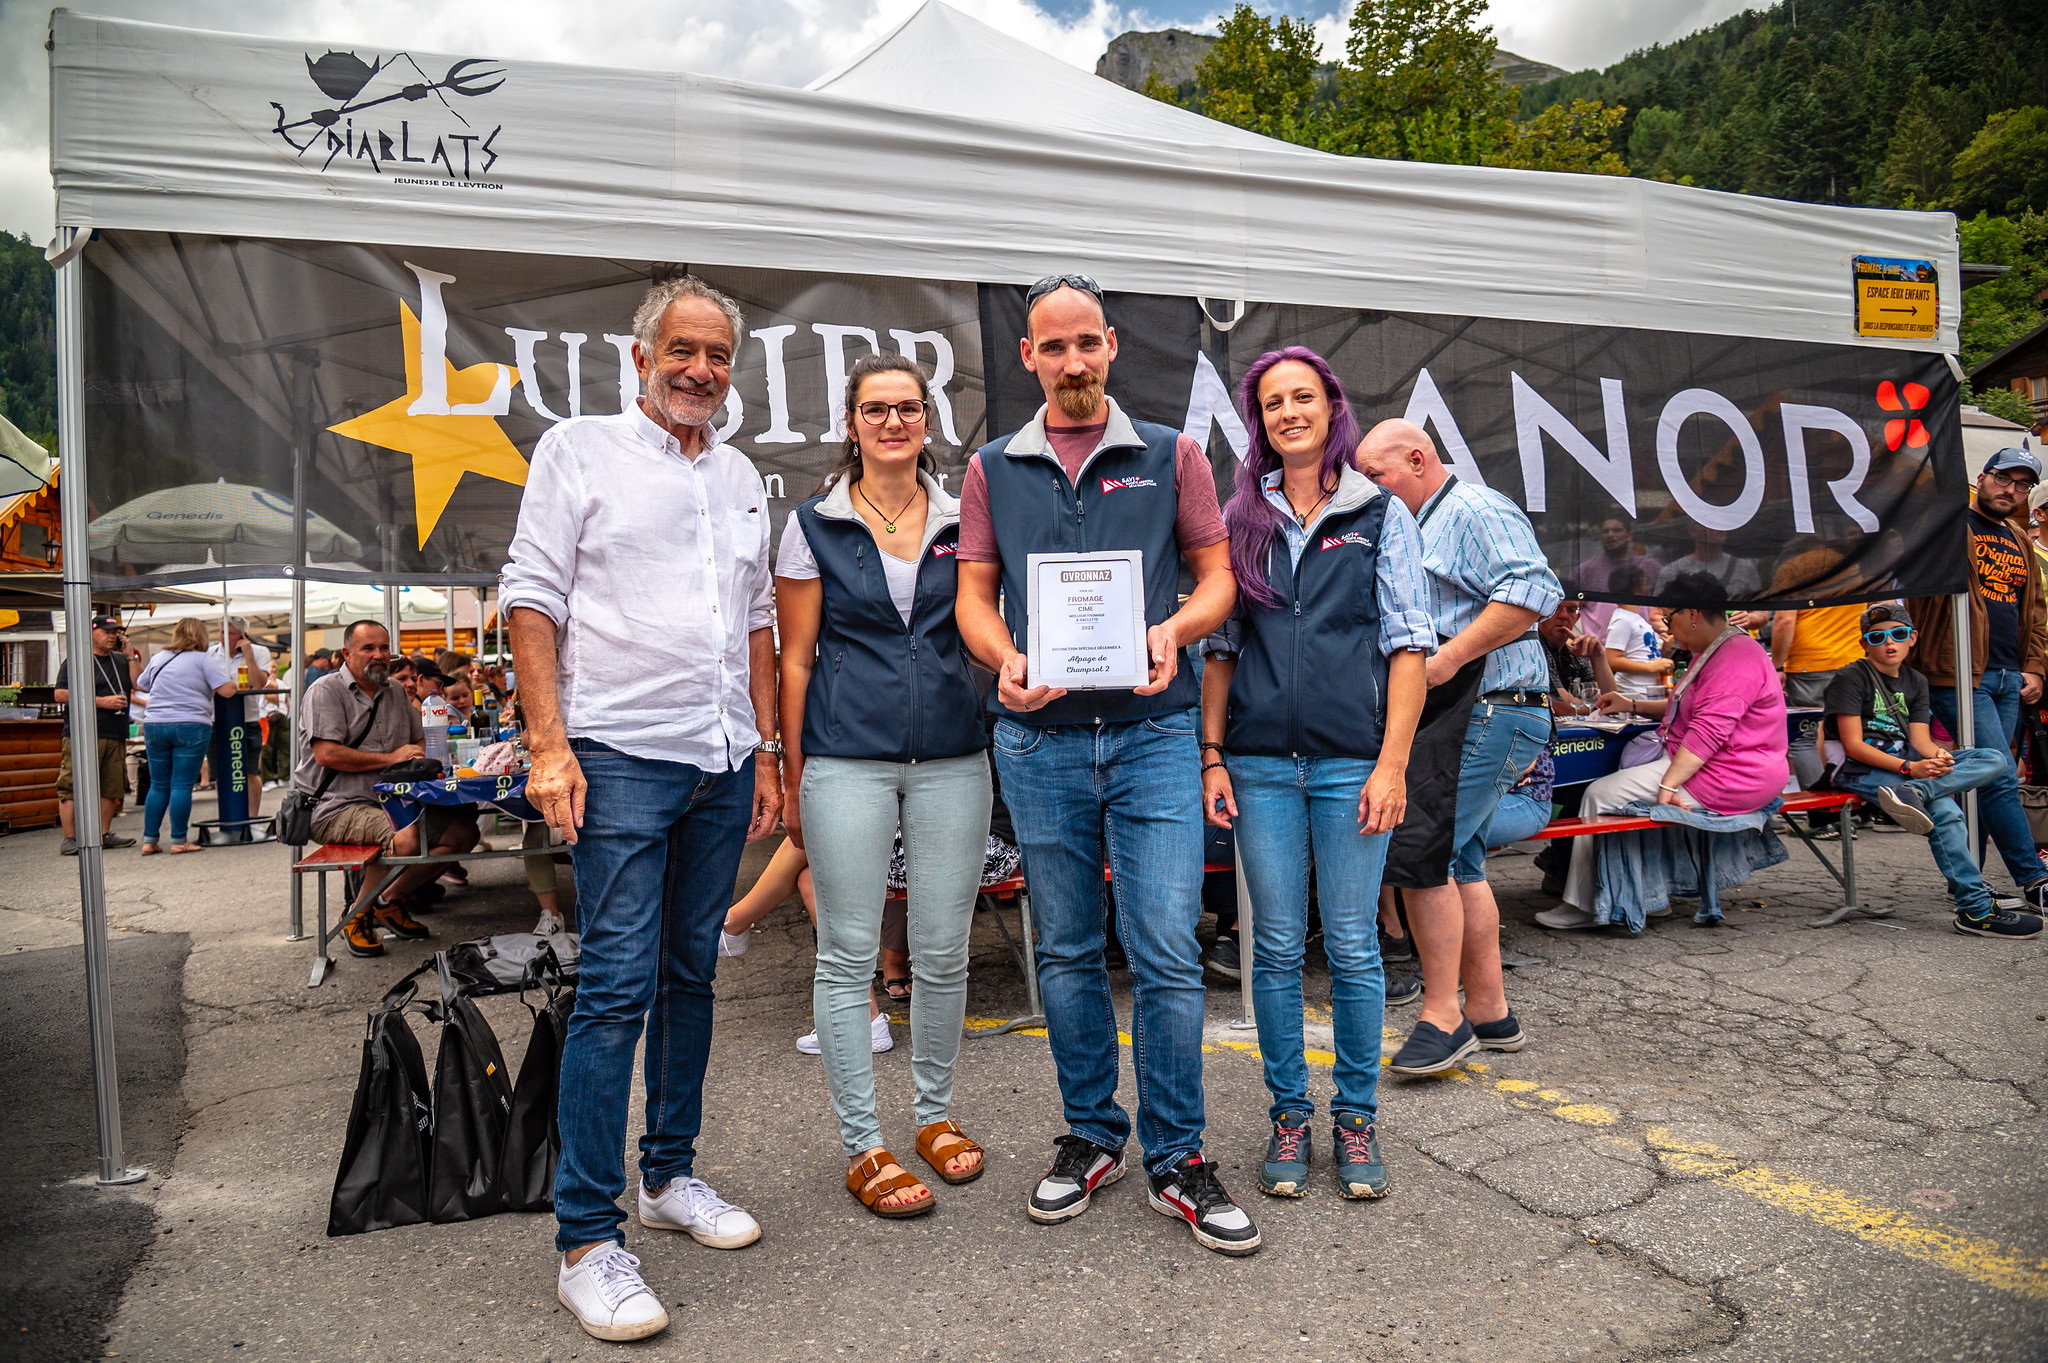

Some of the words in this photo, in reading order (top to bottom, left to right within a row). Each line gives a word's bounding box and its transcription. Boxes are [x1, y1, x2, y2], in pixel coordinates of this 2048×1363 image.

[394, 177, 440, 187] JEUNESSE
[1866, 286, 1890, 299] ESPACE
[1890, 287, 1905, 299] JEUX
[1905, 288, 1930, 301] ENFANTS
[1062, 570, 1111, 582] OVRONNAZ
[1976, 560, 2013, 583] Wear
[1067, 595, 1104, 603] FROMAGE
[1067, 655, 1097, 664] Alpage
[1097, 654, 1108, 662] de
[1105, 665, 1110, 673] 2
[229, 726, 246, 792] Genedis
